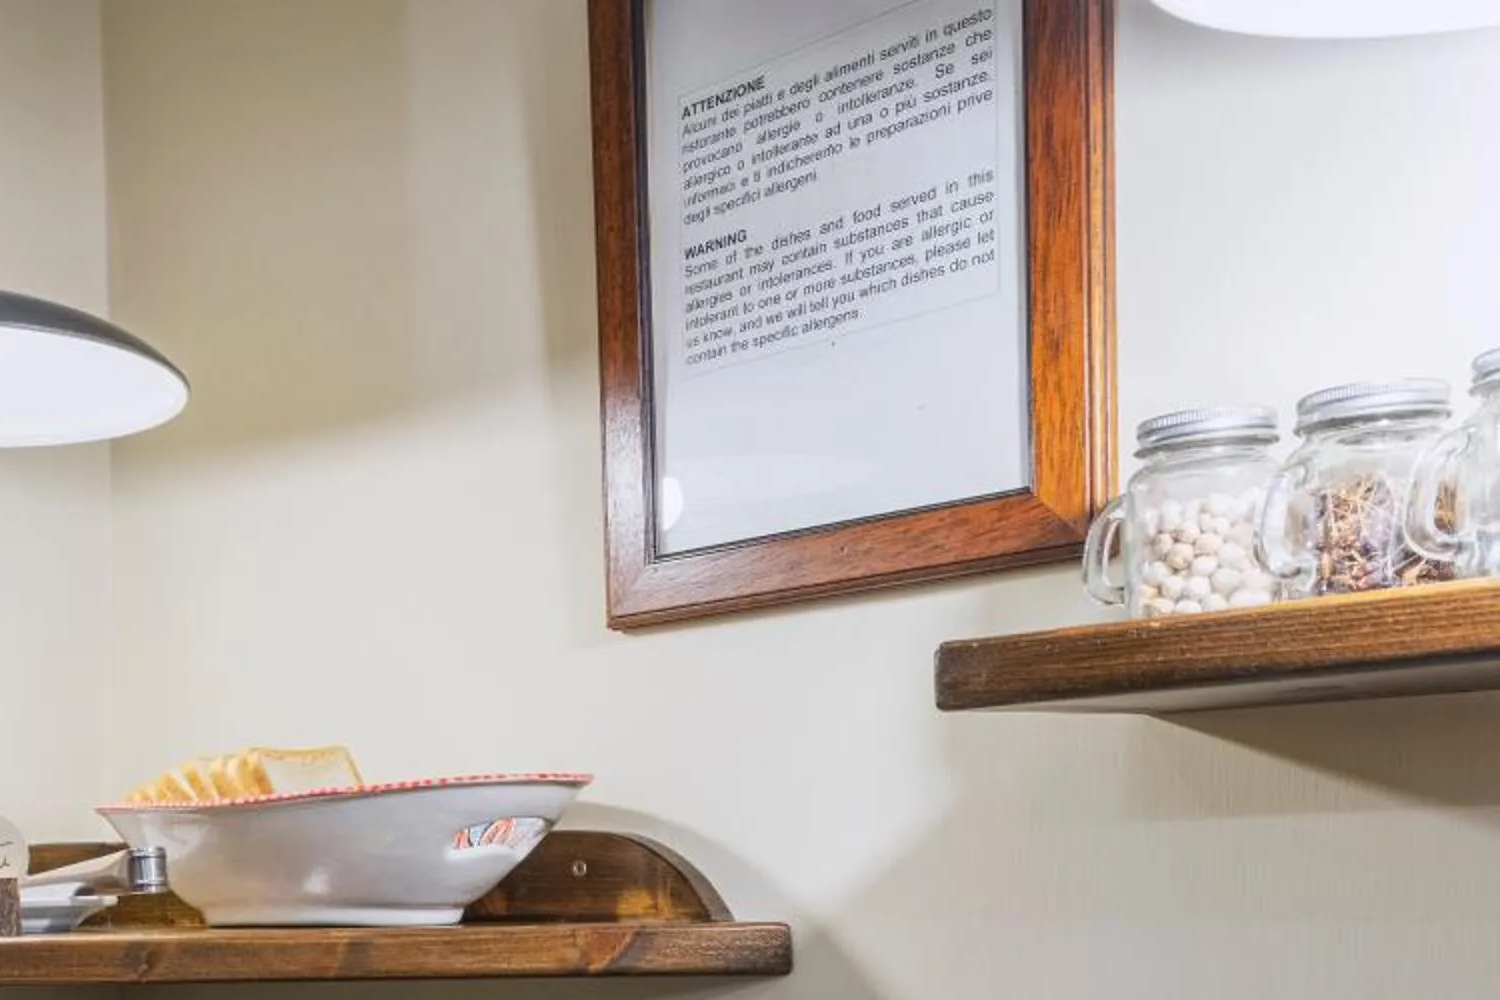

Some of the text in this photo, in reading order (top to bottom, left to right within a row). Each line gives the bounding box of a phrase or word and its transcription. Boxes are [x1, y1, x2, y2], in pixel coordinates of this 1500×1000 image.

[681, 74, 765, 120] ATTENZIONE
[682, 141, 742, 174] provocano
[755, 118, 801, 145] allergie
[815, 111, 823, 124] o
[934, 61, 955, 80] Se
[970, 44, 993, 67] sei
[720, 104, 739, 122] dei
[742, 90, 772, 116] piatti
[776, 88, 785, 101] e
[788, 72, 819, 96] degli
[825, 51, 875, 82] alimenti
[925, 28, 937, 44] in
[942, 8, 992, 39] questo
[742, 98, 810, 134] potrebbero
[818, 70, 884, 103] contenere
[892, 43, 956, 76] sostanze
[964, 28, 993, 49] che
[737, 159, 744, 171] o
[751, 131, 819, 165] intollerante
[824, 121, 841, 139] ad
[847, 113, 873, 131] una
[879, 107, 889, 120] o
[740, 176, 749, 188] e
[866, 101, 951, 147] preparazioni
[956, 89, 993, 116] prive
[683, 204, 710, 226] degli
[712, 187, 760, 217] specifici
[683, 227, 747, 261] WARNING
[684, 168, 994, 278] Some of the dishes and food served in this
[684, 190, 994, 296] restaurant may contain substances that cause
[684, 303, 739, 331] intolerant
[742, 300, 754, 314] to
[757, 293, 780, 310] one
[784, 288, 798, 302] or
[802, 277, 836, 297] more
[924, 237, 971, 263] please
[976, 227, 995, 246] let
[685, 211, 993, 313] allergies or intolerances. If you are allergic or
[739, 314, 763, 333] and
[765, 311, 783, 326] we
[786, 301, 807, 320] will
[809, 295, 829, 313] tell
[831, 290, 855, 310] you
[859, 275, 897, 299] which
[900, 265, 945, 287] dishes
[949, 257, 967, 274] do
[971, 247, 995, 267] not
[685, 344, 727, 366] contain
[730, 338, 748, 354] the
[751, 324, 801, 348] specific
